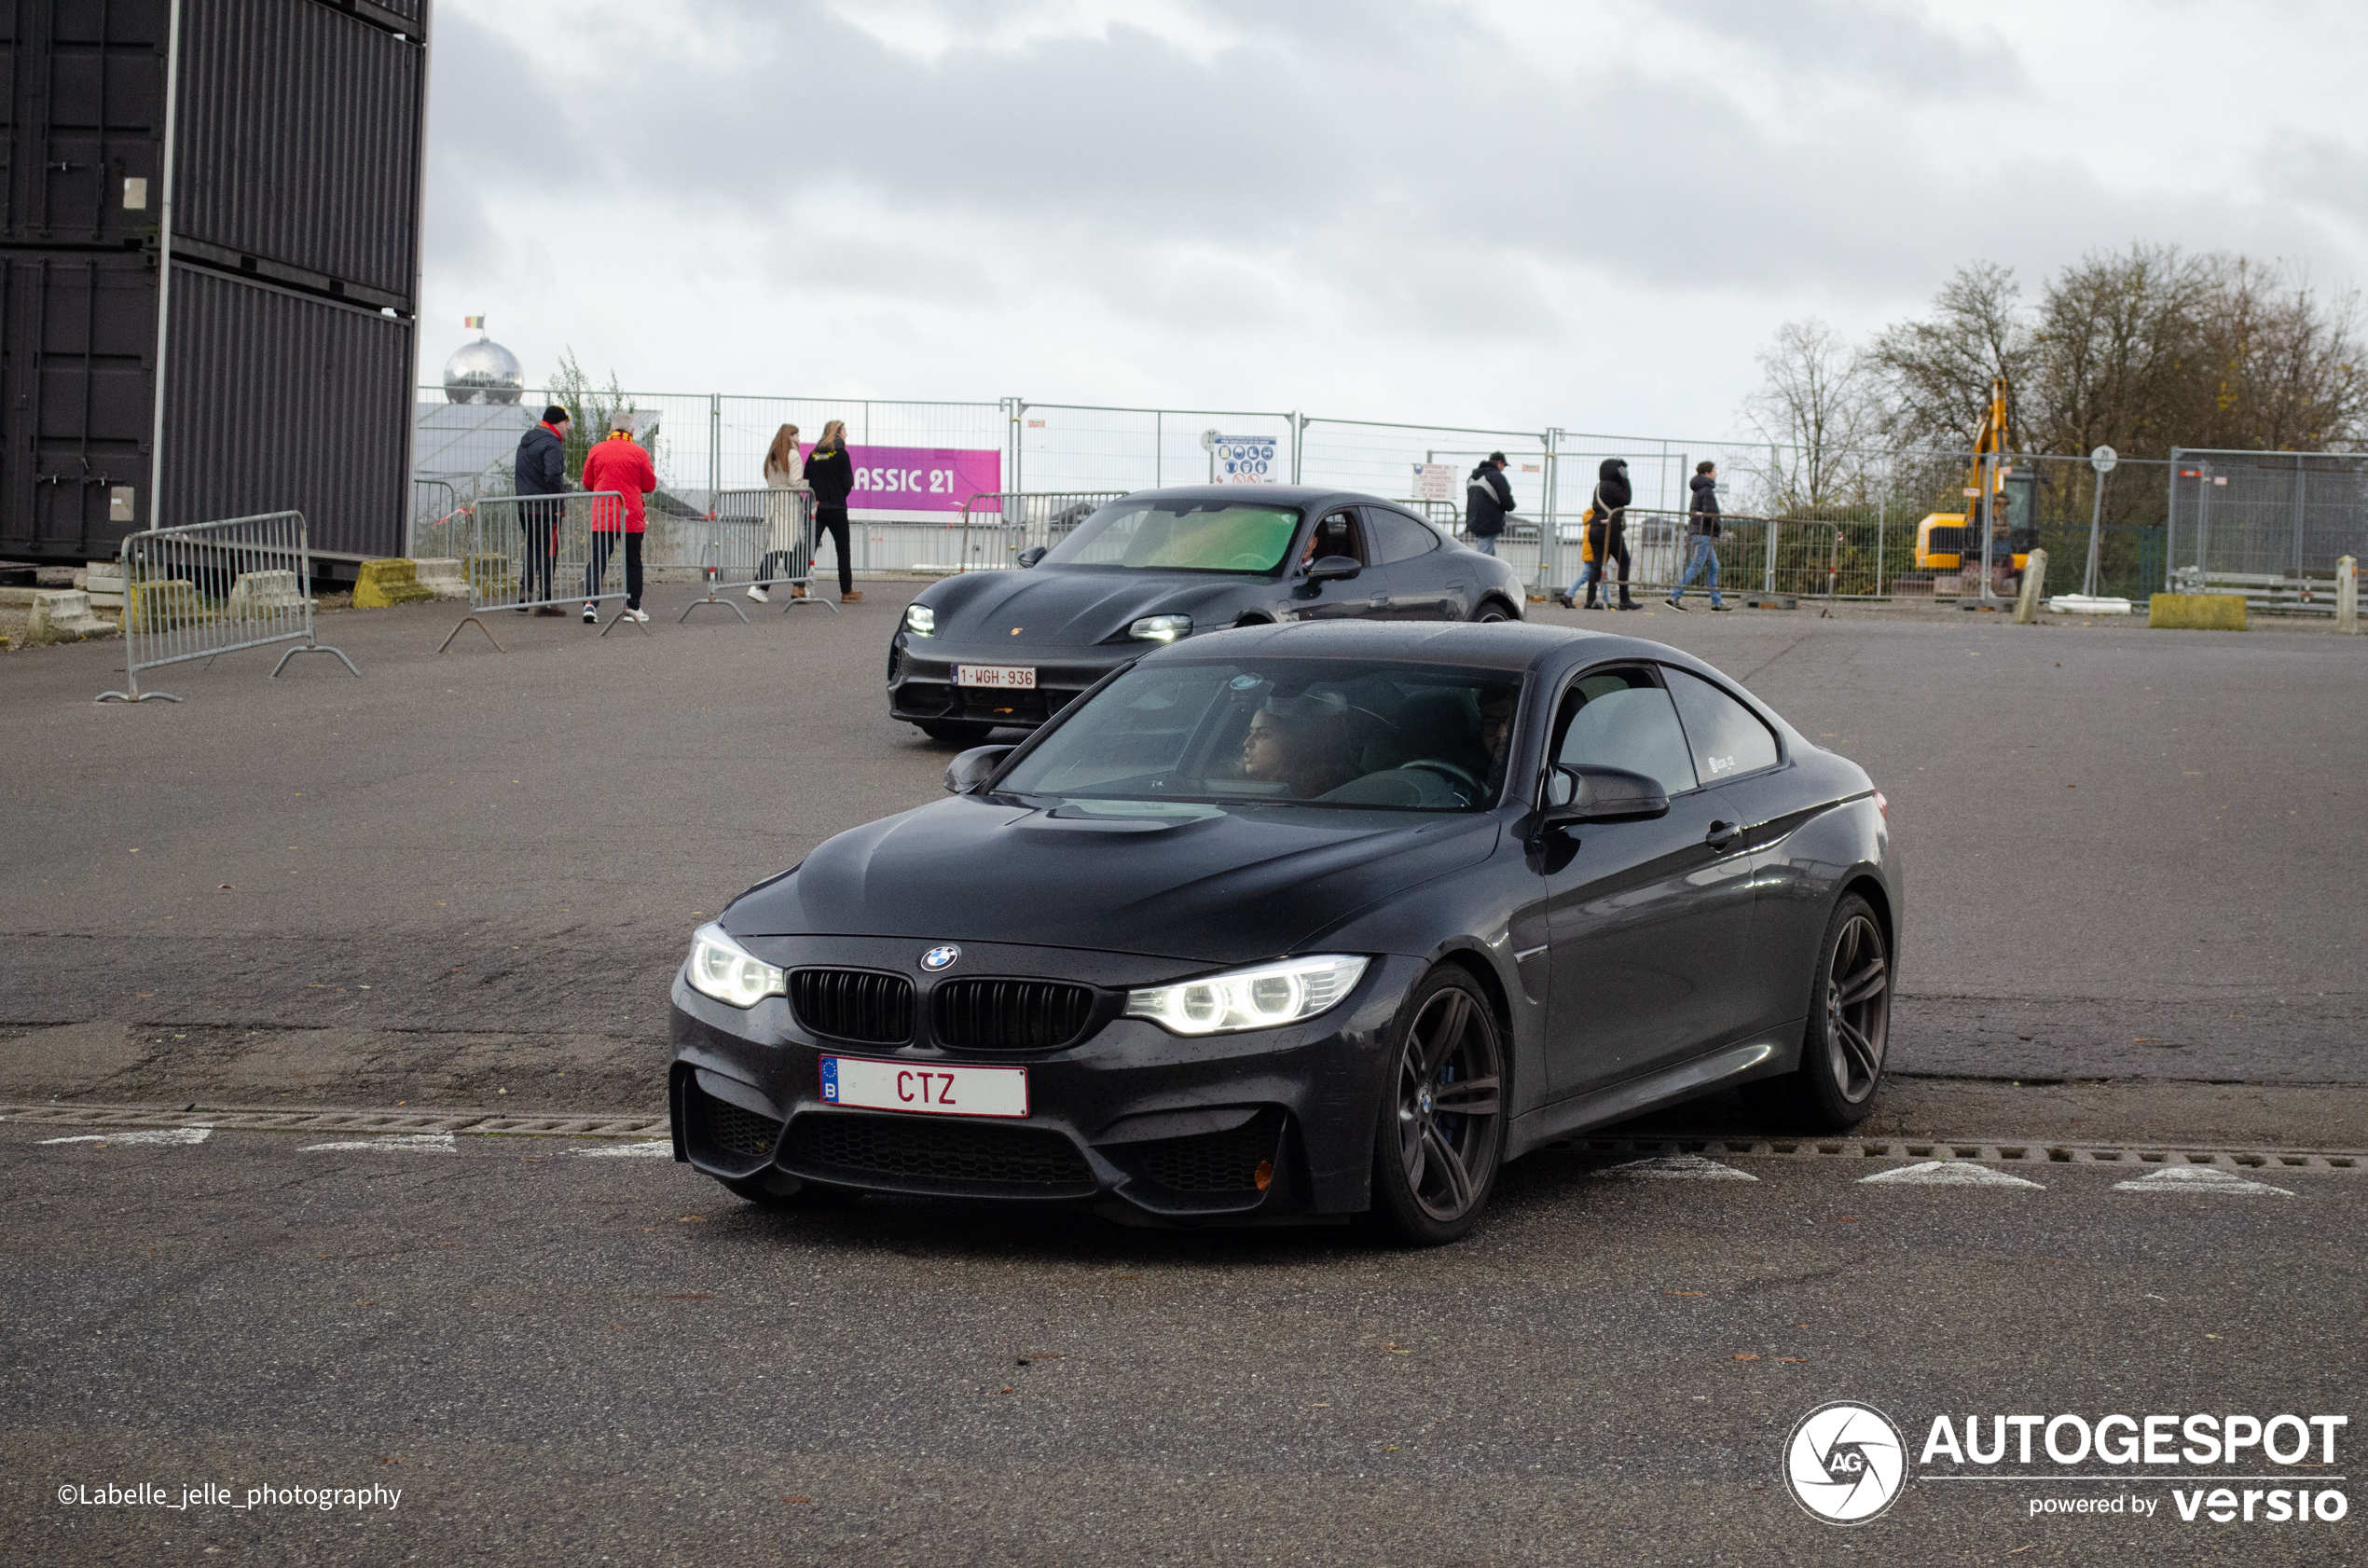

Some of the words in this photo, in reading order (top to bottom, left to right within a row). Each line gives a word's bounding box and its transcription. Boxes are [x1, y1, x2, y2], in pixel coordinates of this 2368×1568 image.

[852, 467, 922, 492] ASSIC
[929, 469, 954, 493] 21
[961, 668, 1033, 685] 1-WGH-936
[825, 1082, 836, 1098] B
[897, 1070, 957, 1105] CTZ
